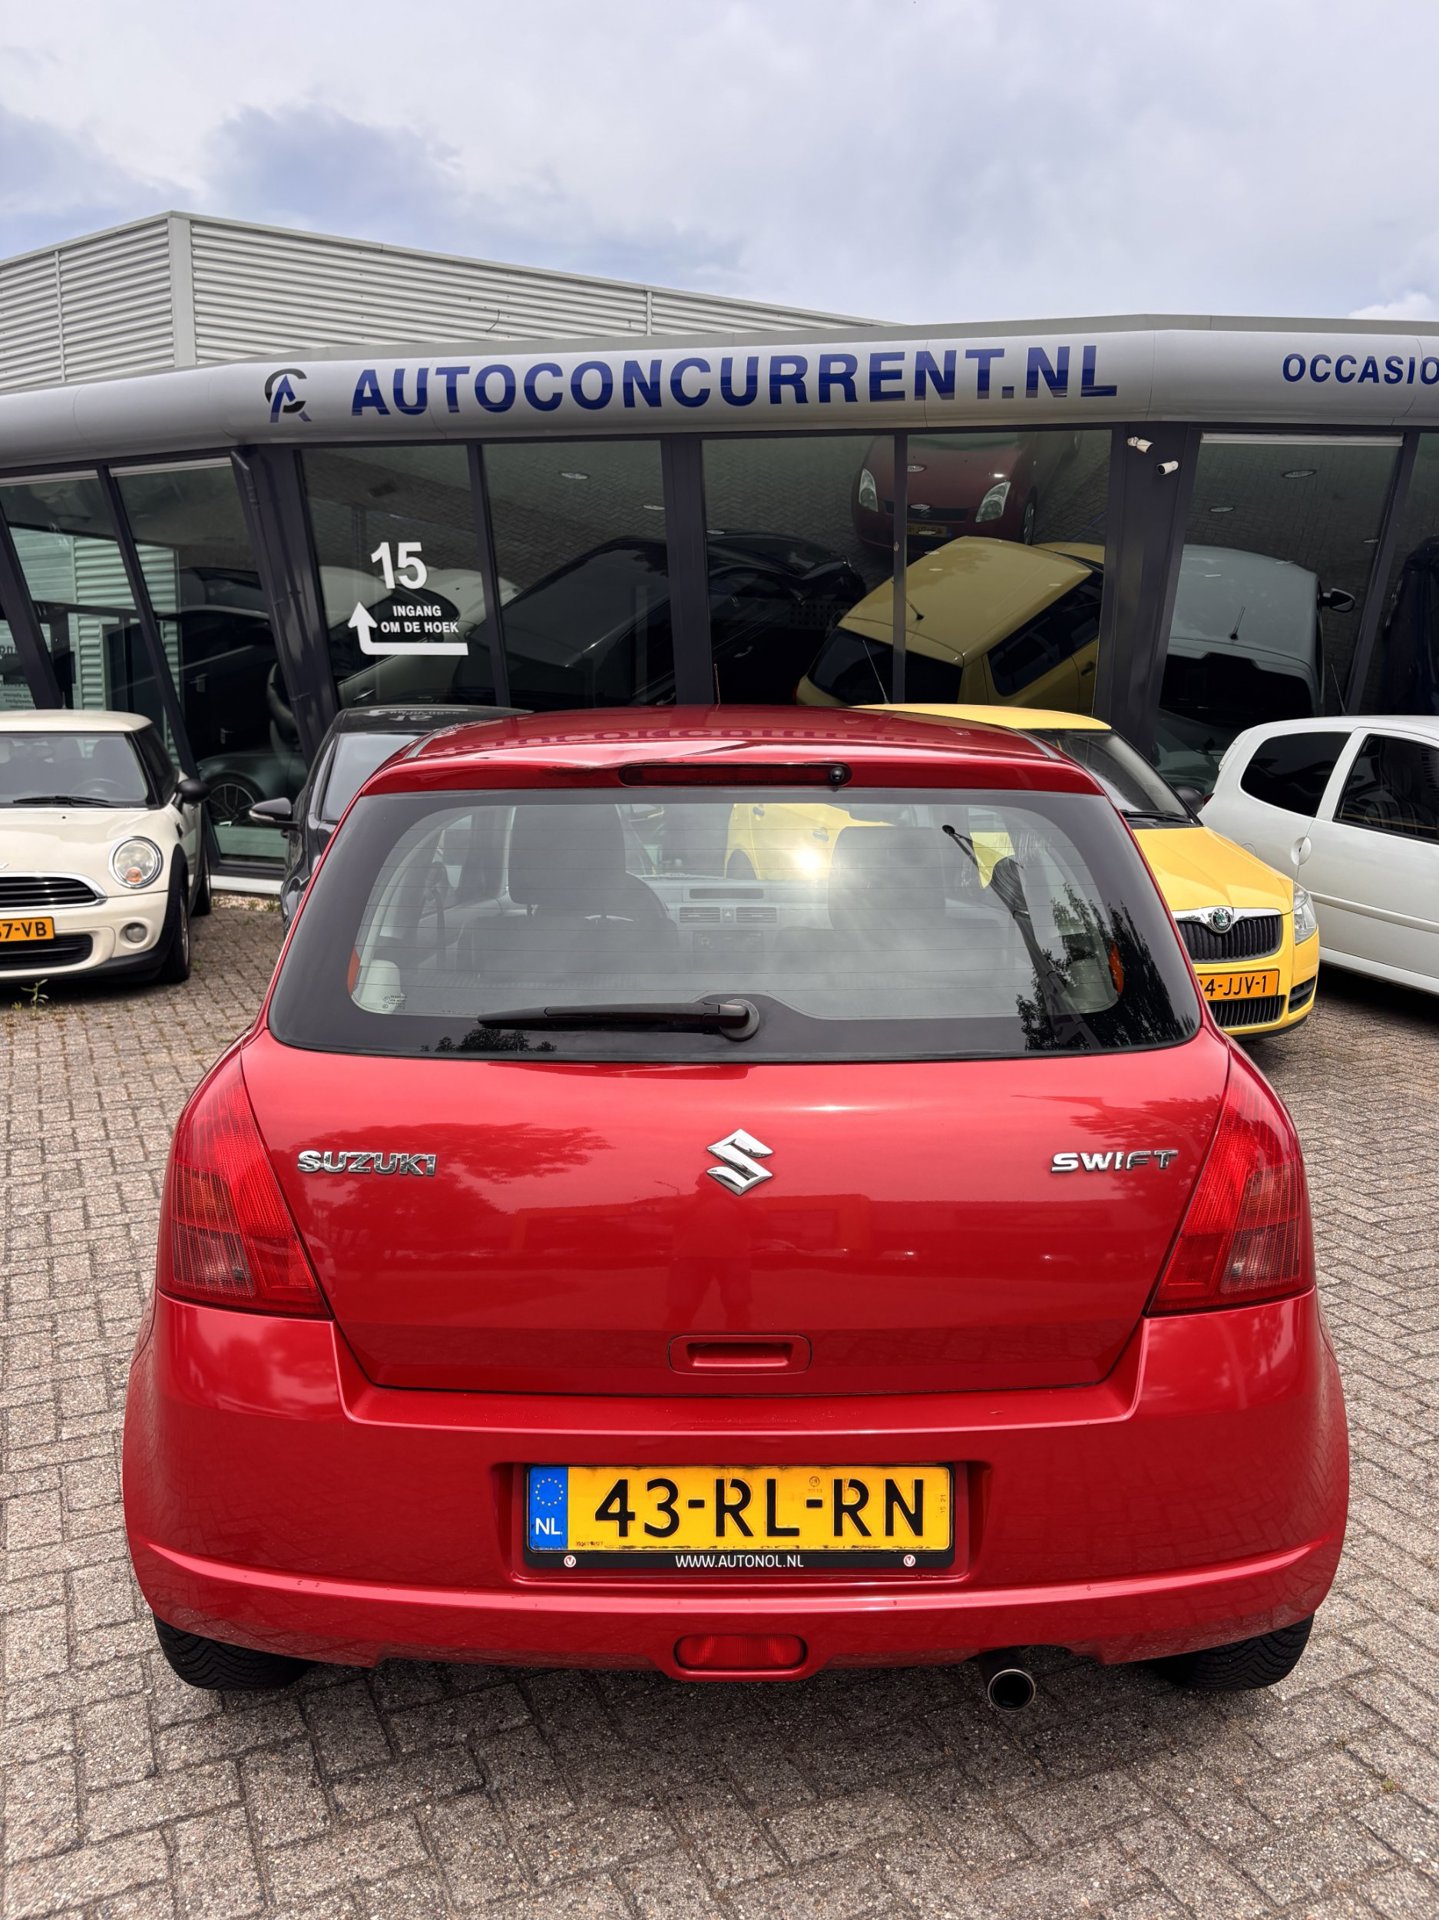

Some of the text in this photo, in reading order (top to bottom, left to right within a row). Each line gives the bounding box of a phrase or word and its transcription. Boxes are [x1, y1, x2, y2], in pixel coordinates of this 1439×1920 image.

[351, 345, 1118, 416] AUTOCONCURRENT.NL
[1282, 353, 1439, 385] OCCASIO
[370, 541, 428, 590] 15
[392, 605, 442, 617] INGANG
[380, 621, 459, 633] OM DE HOEK
[0, 921, 47, 939] 7-VB
[1199, 975, 1267, 997] 4-JJV-1
[297, 1149, 437, 1177] SUZUKI
[1051, 1149, 1179, 1173] SWIFT
[594, 1477, 925, 1538] 43-RL-RN
[534, 1517, 563, 1536] NL
[674, 1554, 804, 1568] WWW.AUTONOL.NL
